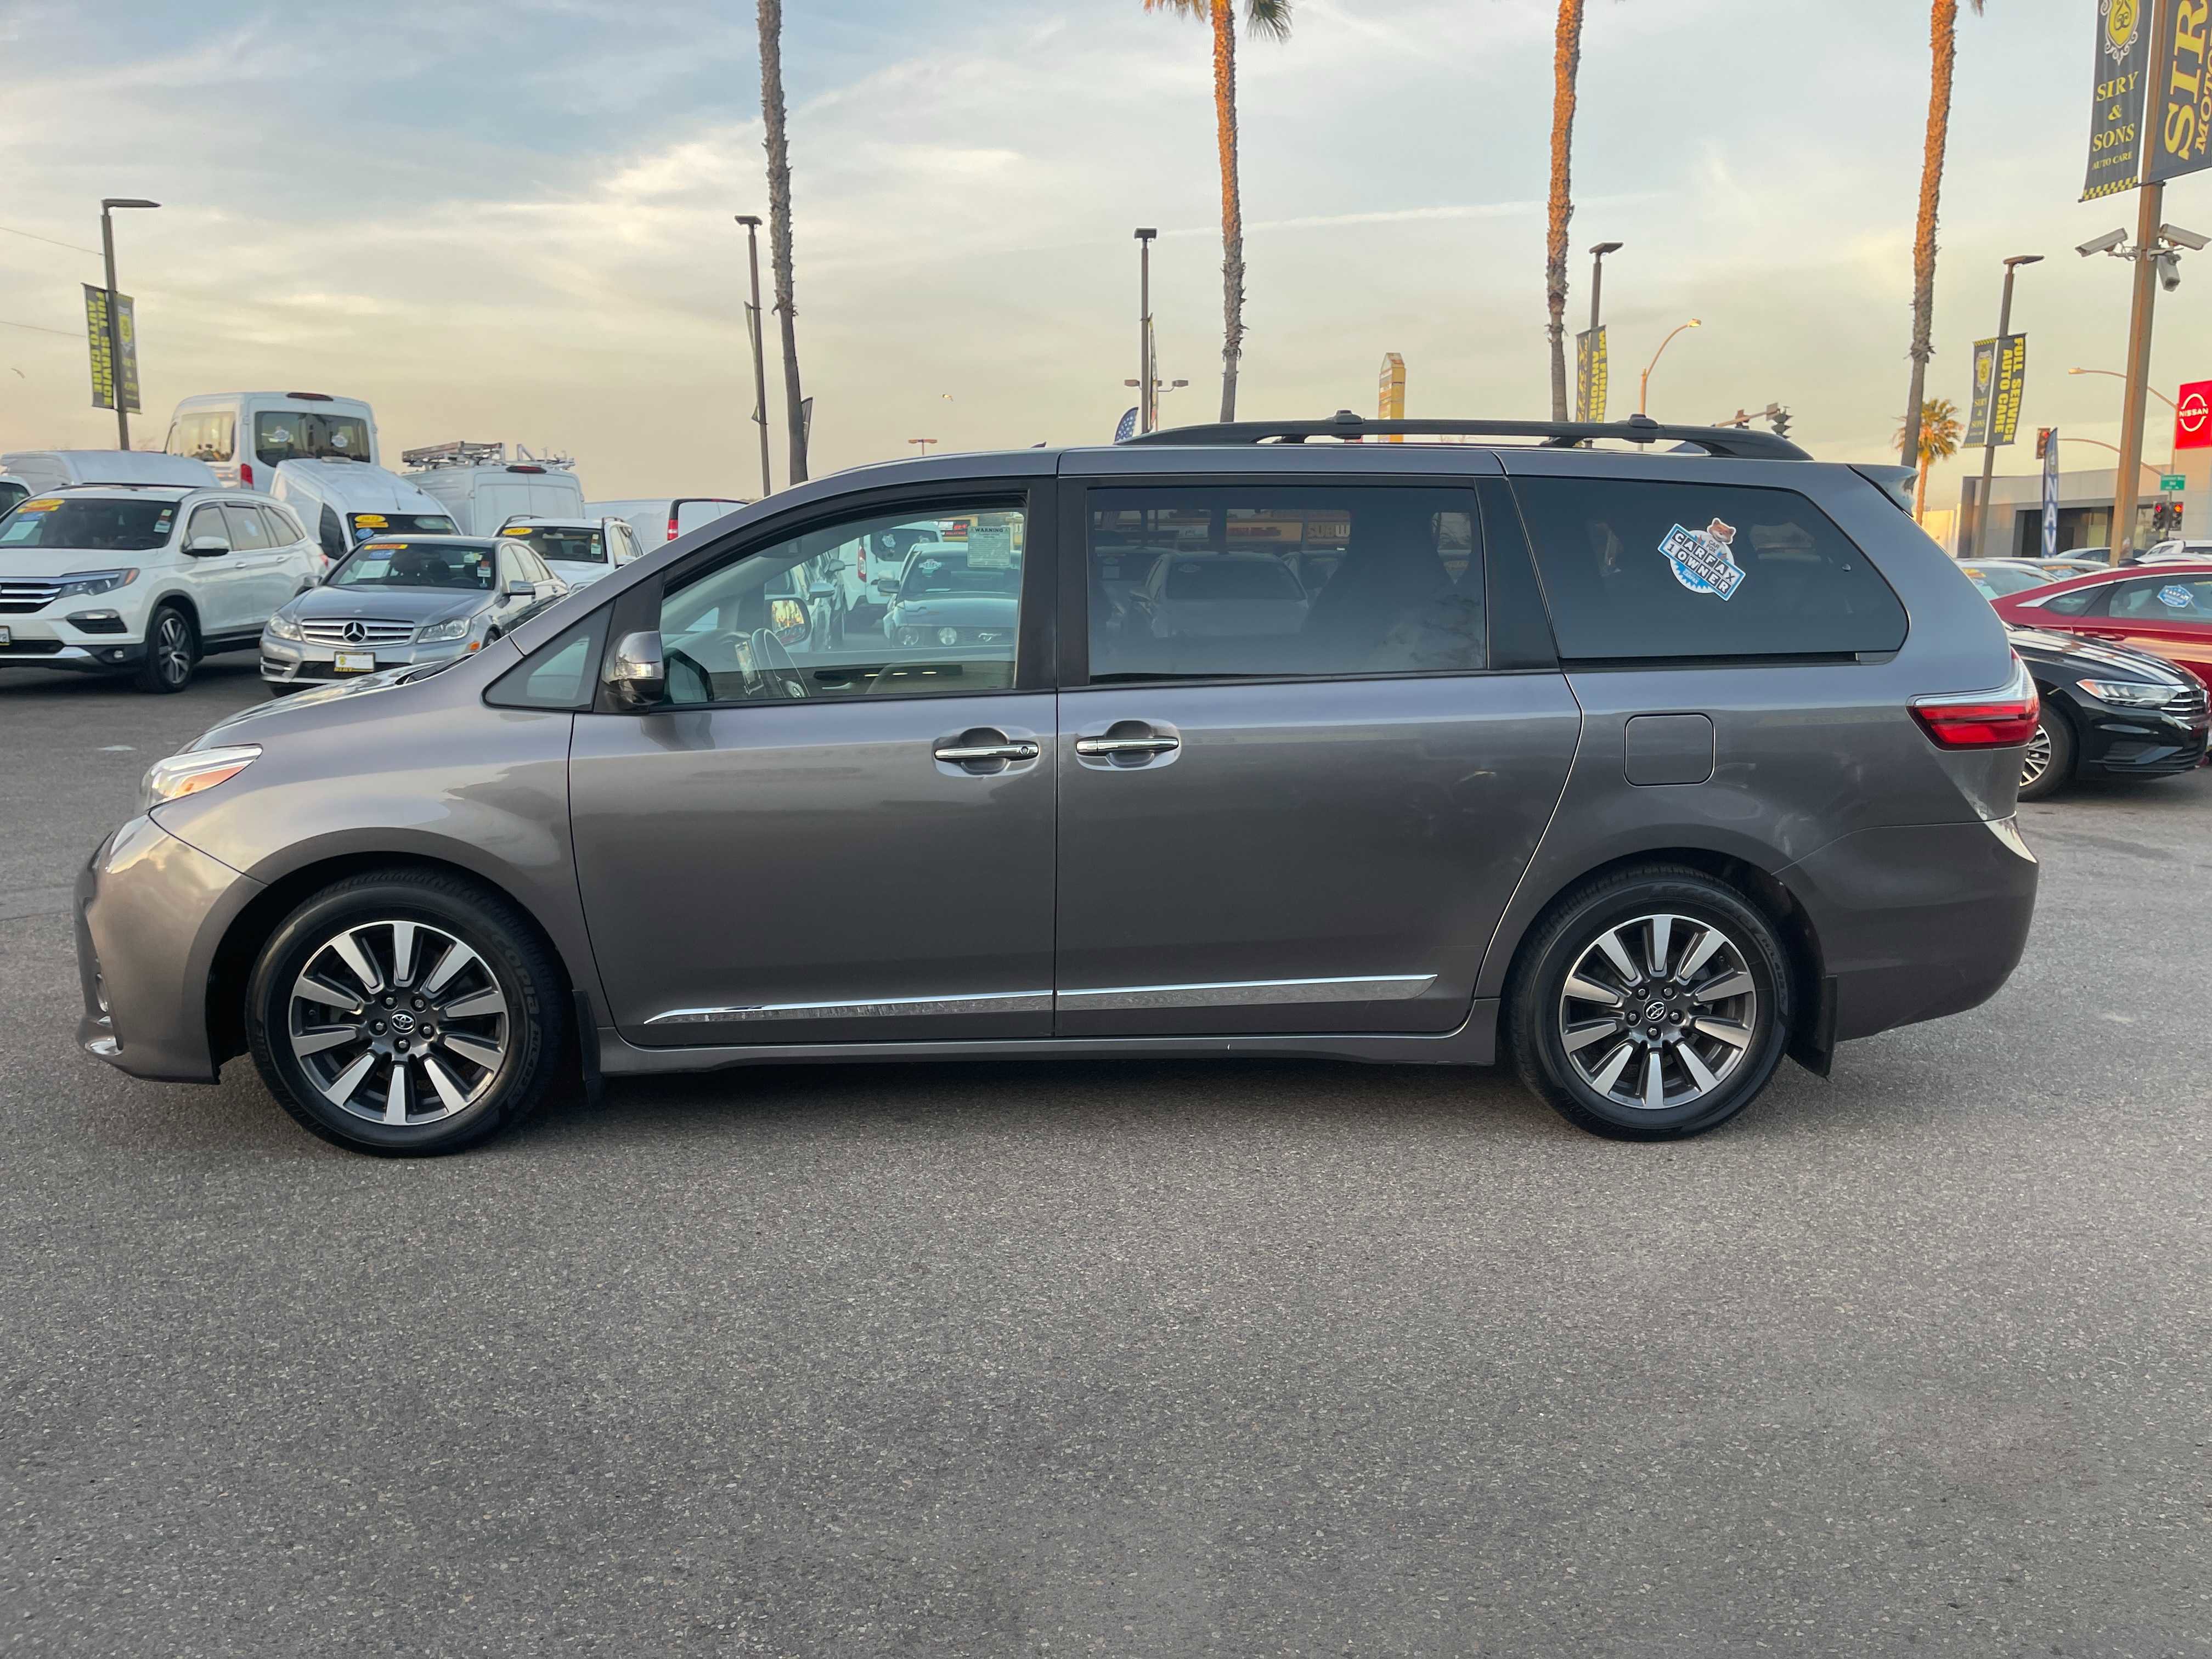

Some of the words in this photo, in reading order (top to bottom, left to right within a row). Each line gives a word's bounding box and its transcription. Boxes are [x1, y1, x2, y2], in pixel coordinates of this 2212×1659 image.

[2096, 71, 2139, 101] SIRY
[2107, 104, 2122, 121] &
[2092, 123, 2135, 151] SONS
[2092, 157, 2112, 170] AUTO
[2112, 151, 2133, 164] CARE
[87, 300, 99, 346] AUTO
[96, 291, 108, 328] FULL
[1599, 330, 1606, 359] WE
[2013, 337, 2024, 373] FULL
[91, 349, 103, 393] CARE
[100, 336, 112, 404] SERVICE
[1589, 351, 1599, 419] ANYONE
[1999, 348, 2013, 391] AUTO
[1994, 392, 2009, 434] CARE
[2003, 377, 2022, 443] SERVICE
[2179, 407, 2209, 417] NISSAN
[2044, 476, 2057, 557] NAV
[1674, 533, 1735, 582] CARFAX
[1708, 539, 1720, 549] CAR
[1667, 544, 1675, 553] 1
[1677, 551, 1729, 592] OWNER
